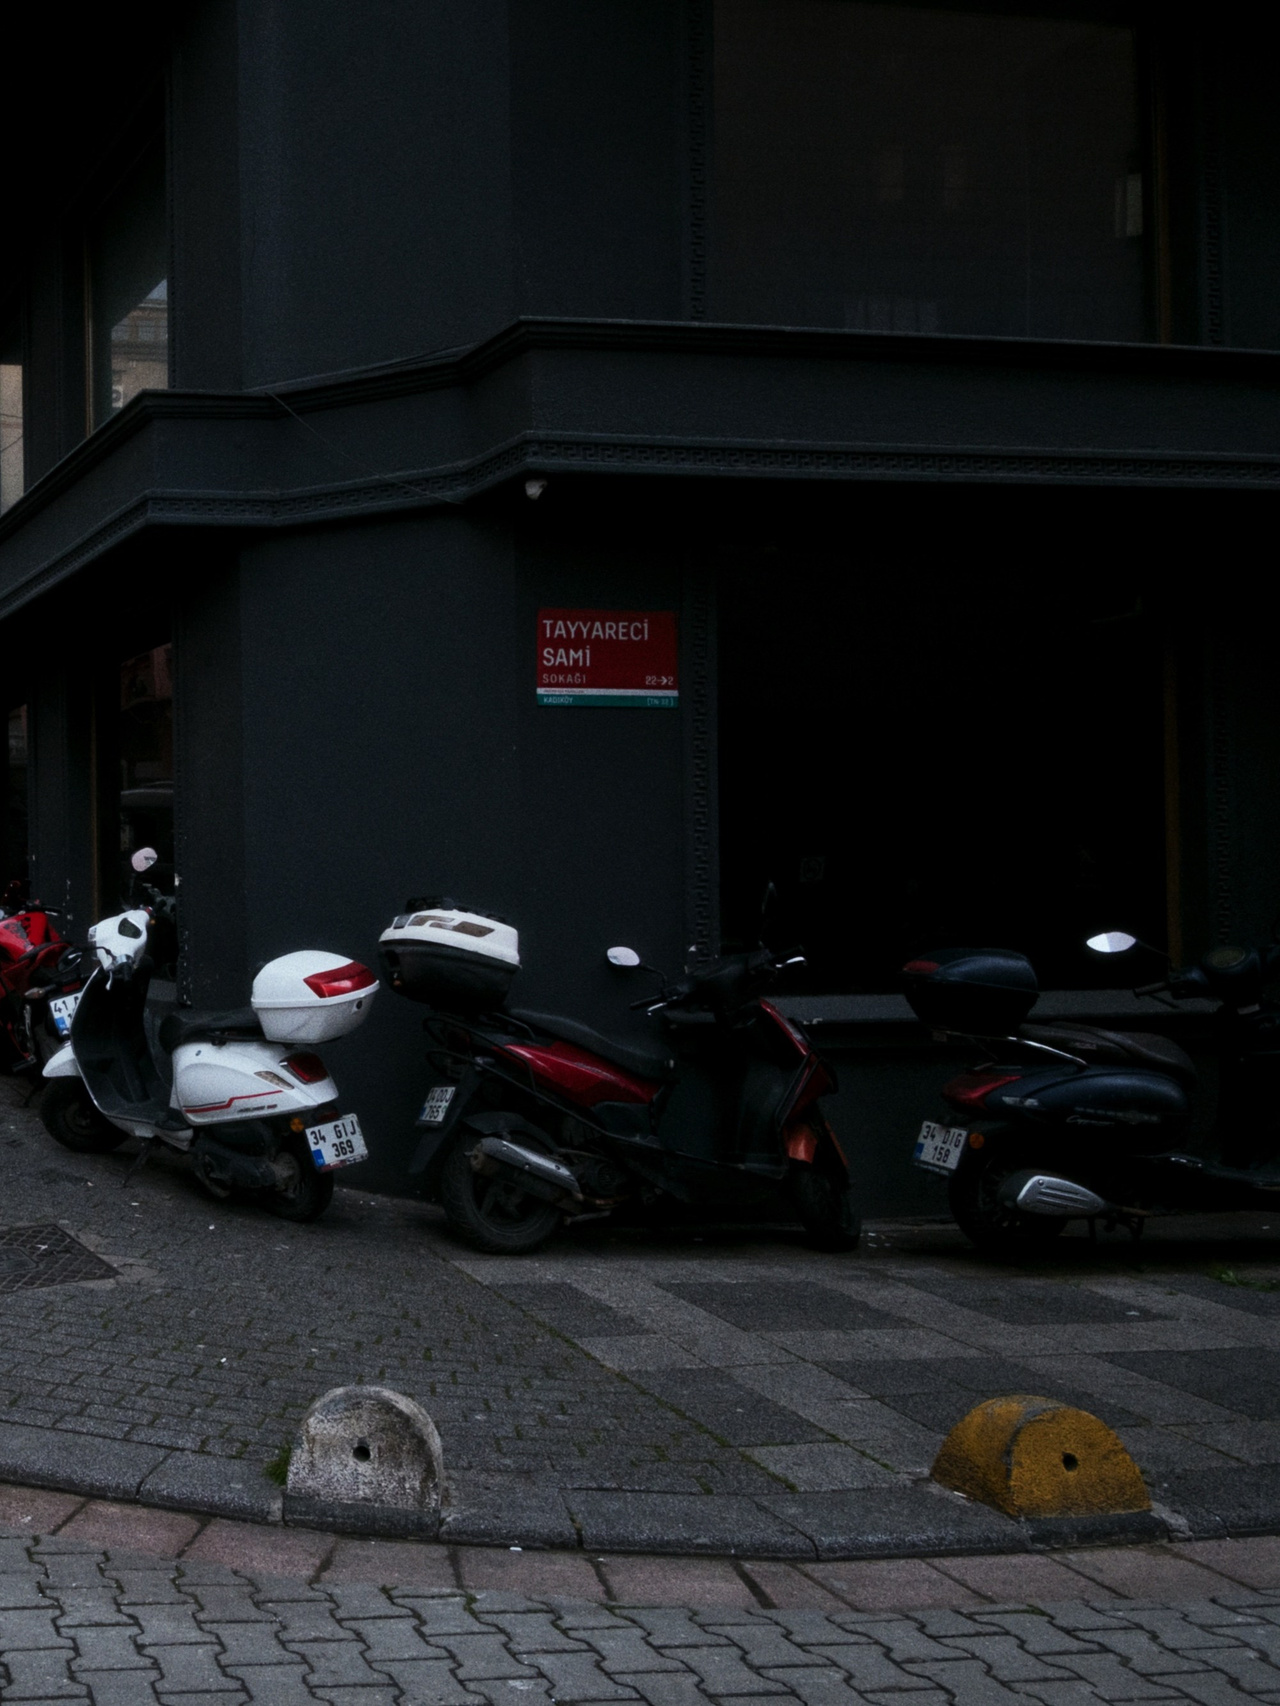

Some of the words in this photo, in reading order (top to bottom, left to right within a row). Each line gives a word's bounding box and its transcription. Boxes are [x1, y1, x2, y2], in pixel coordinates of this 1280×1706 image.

[542, 618, 649, 641] TAYYARECİ
[542, 645, 591, 667] SAMİ
[542, 672, 587, 684] SOKAĞI
[310, 1129, 326, 1145] 34
[333, 1120, 356, 1139] GIJ
[923, 1125, 937, 1141] 34
[942, 1130, 963, 1148] DIG
[332, 1139, 355, 1157] 369
[932, 1145, 951, 1163] 158
